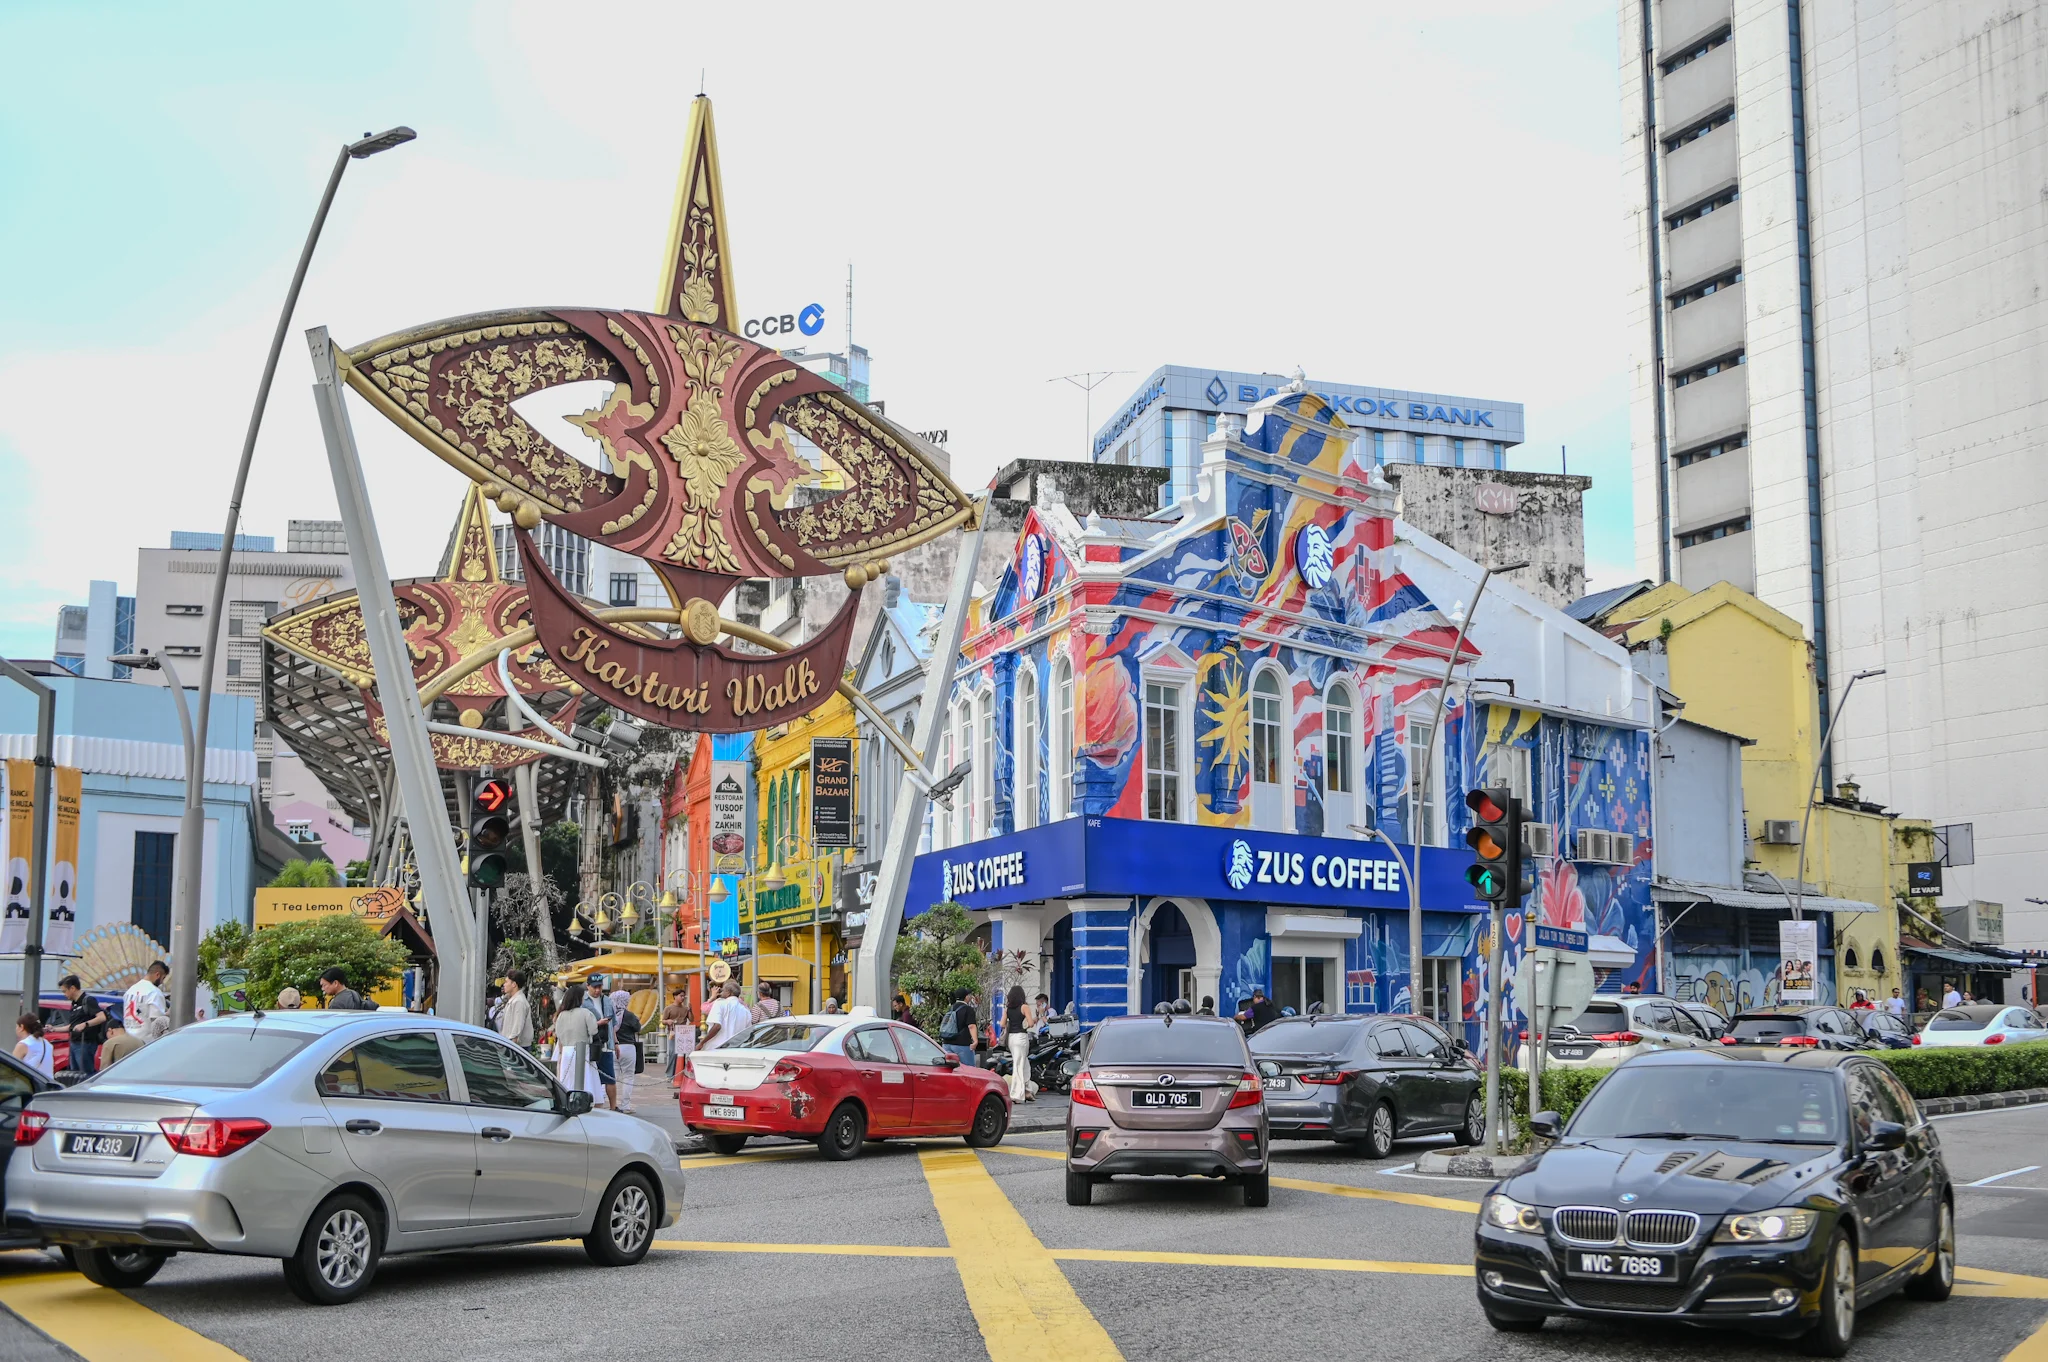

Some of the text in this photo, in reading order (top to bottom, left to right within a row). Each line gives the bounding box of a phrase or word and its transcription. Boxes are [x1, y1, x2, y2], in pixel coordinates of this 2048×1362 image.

[744, 314, 795, 338] CCB
[1136, 377, 1167, 416] BANK
[1408, 403, 1494, 428] BANK
[1478, 488, 1515, 509] KYH
[560, 626, 820, 717] Kasturi Walk
[816, 774, 849, 785] GRAND
[721, 782, 738, 791] RUZ
[815, 786, 850, 797] BAZAAR
[714, 803, 744, 812] YUSOOF
[714, 821, 742, 830] ZAKHIR
[1087, 819, 1102, 828] KAFE
[952, 850, 1025, 896] ZUS COFFEE
[1256, 850, 1400, 892] ZUS COFFEE
[1921, 886, 1941, 894] VAPE
[272, 902, 344, 912] T Tea Lemon
[1268, 1078, 1286, 1088] 7438
[1145, 1093, 1188, 1105] QLD 705
[72, 1136, 123, 1154] DFK 4313
[1581, 1253, 1662, 1275] WVC 7669
